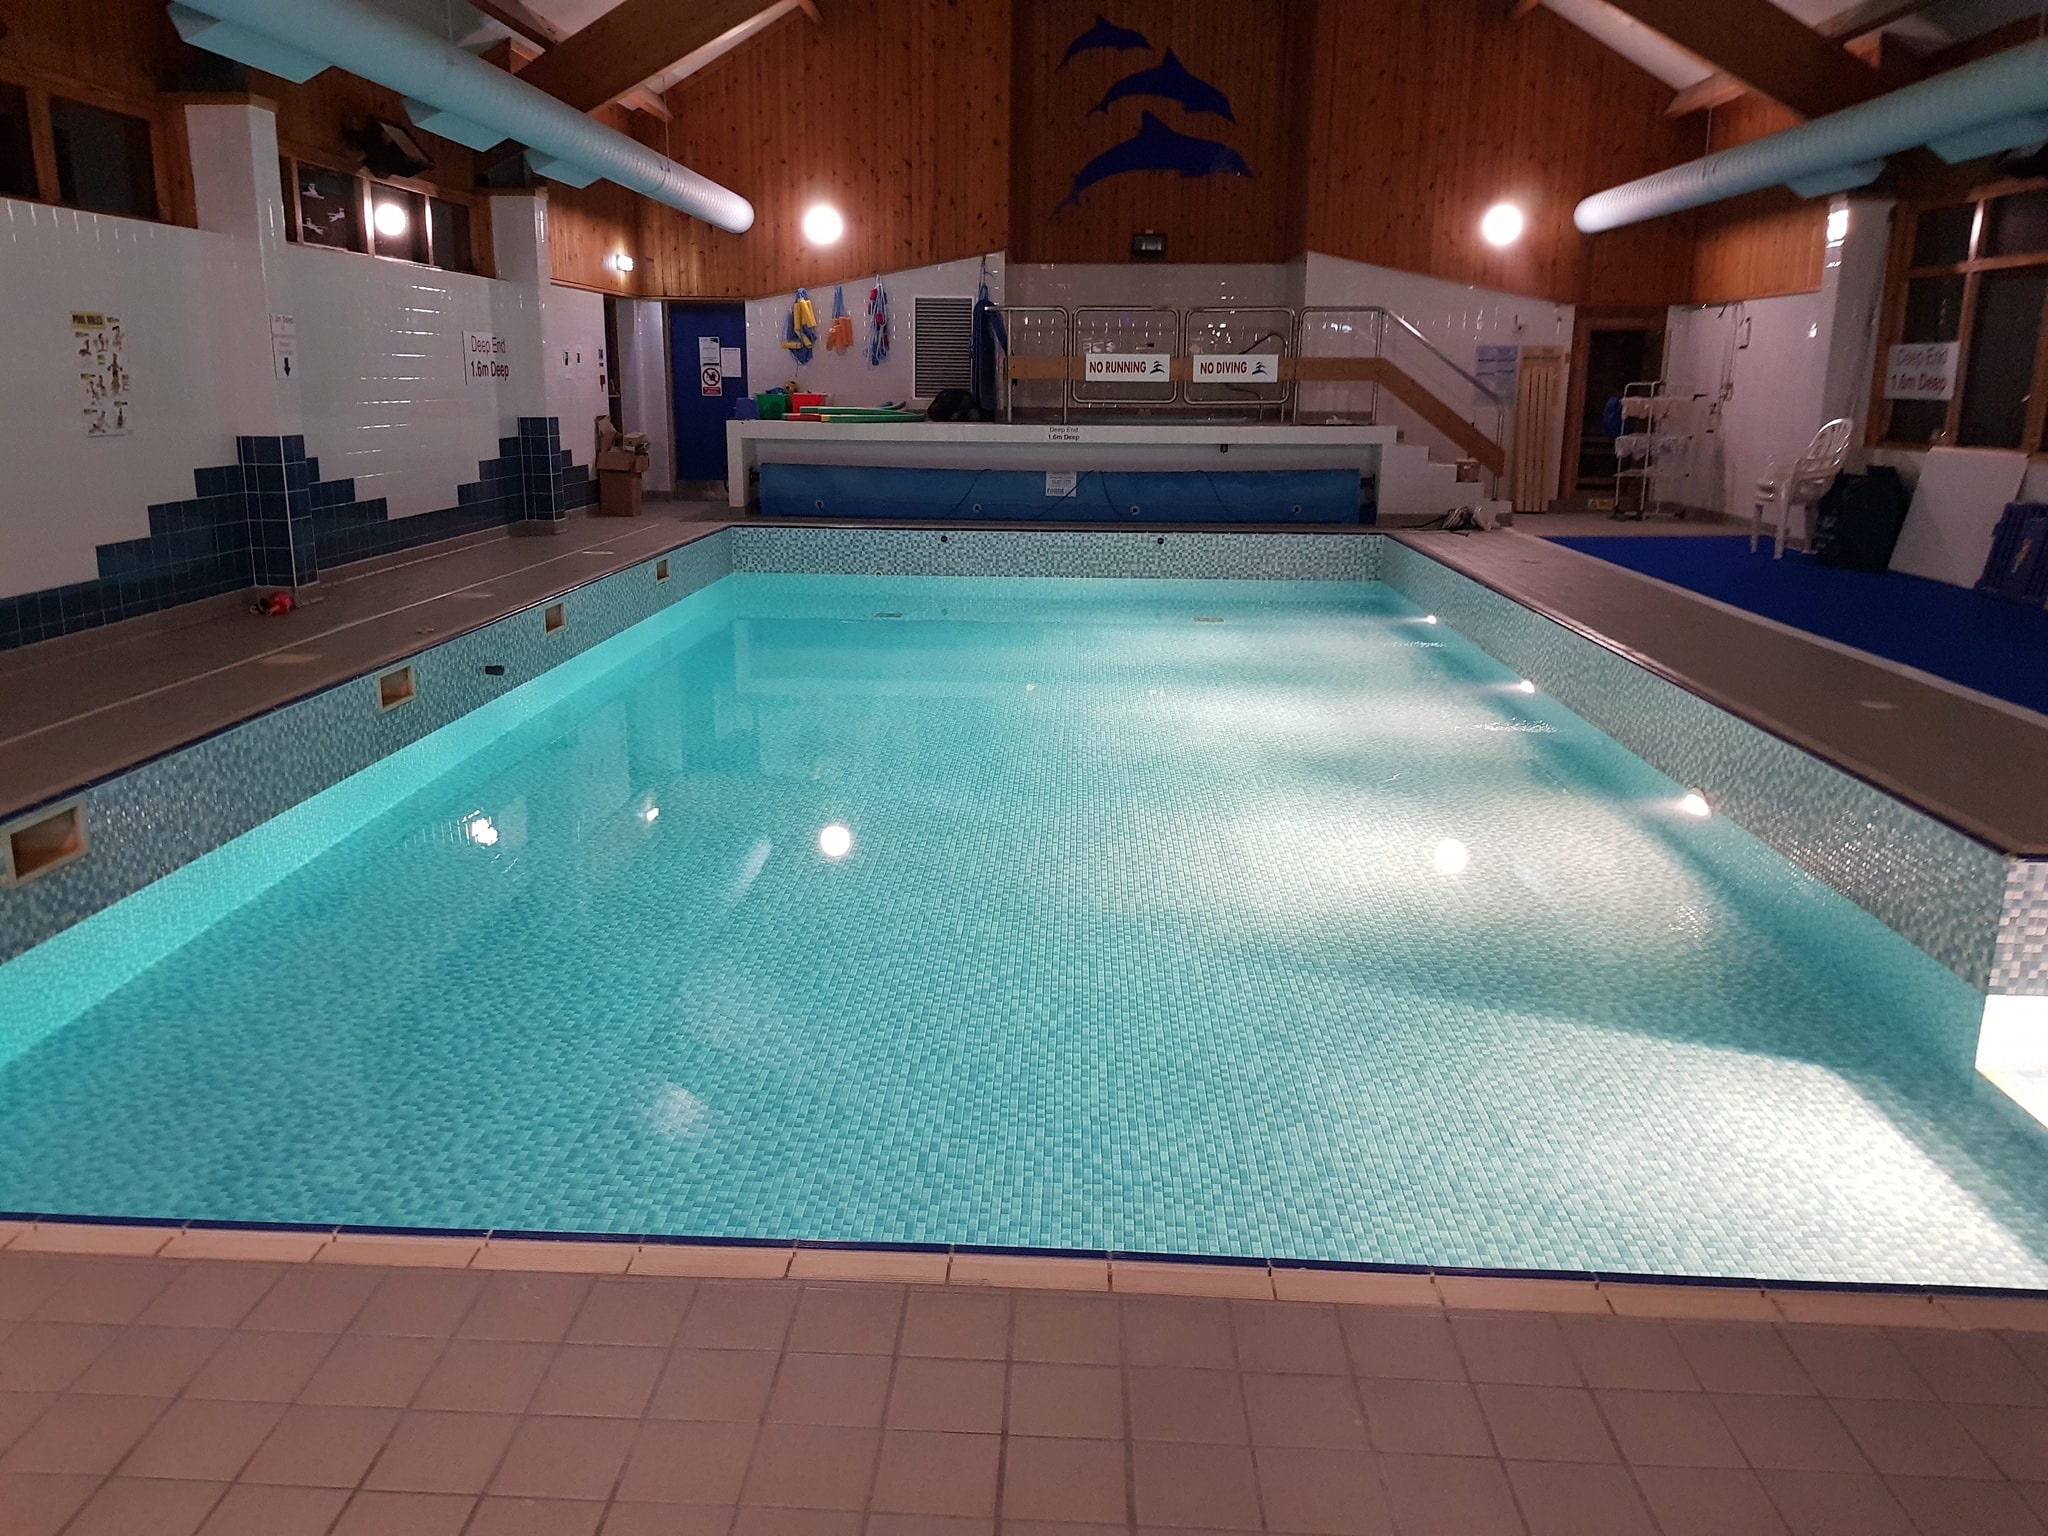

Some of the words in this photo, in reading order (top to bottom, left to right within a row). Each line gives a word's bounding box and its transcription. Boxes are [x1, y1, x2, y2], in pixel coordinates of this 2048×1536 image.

[471, 335, 490, 356] Deep
[492, 337, 506, 353] End
[471, 360, 489, 377] 1.6m
[491, 360, 509, 381] Deep
[1089, 361, 1104, 374] NO
[1105, 361, 1147, 374] RUNNING
[1200, 362, 1214, 374] NO
[1216, 361, 1248, 374] DIVING
[1918, 372, 1948, 396] Deep
